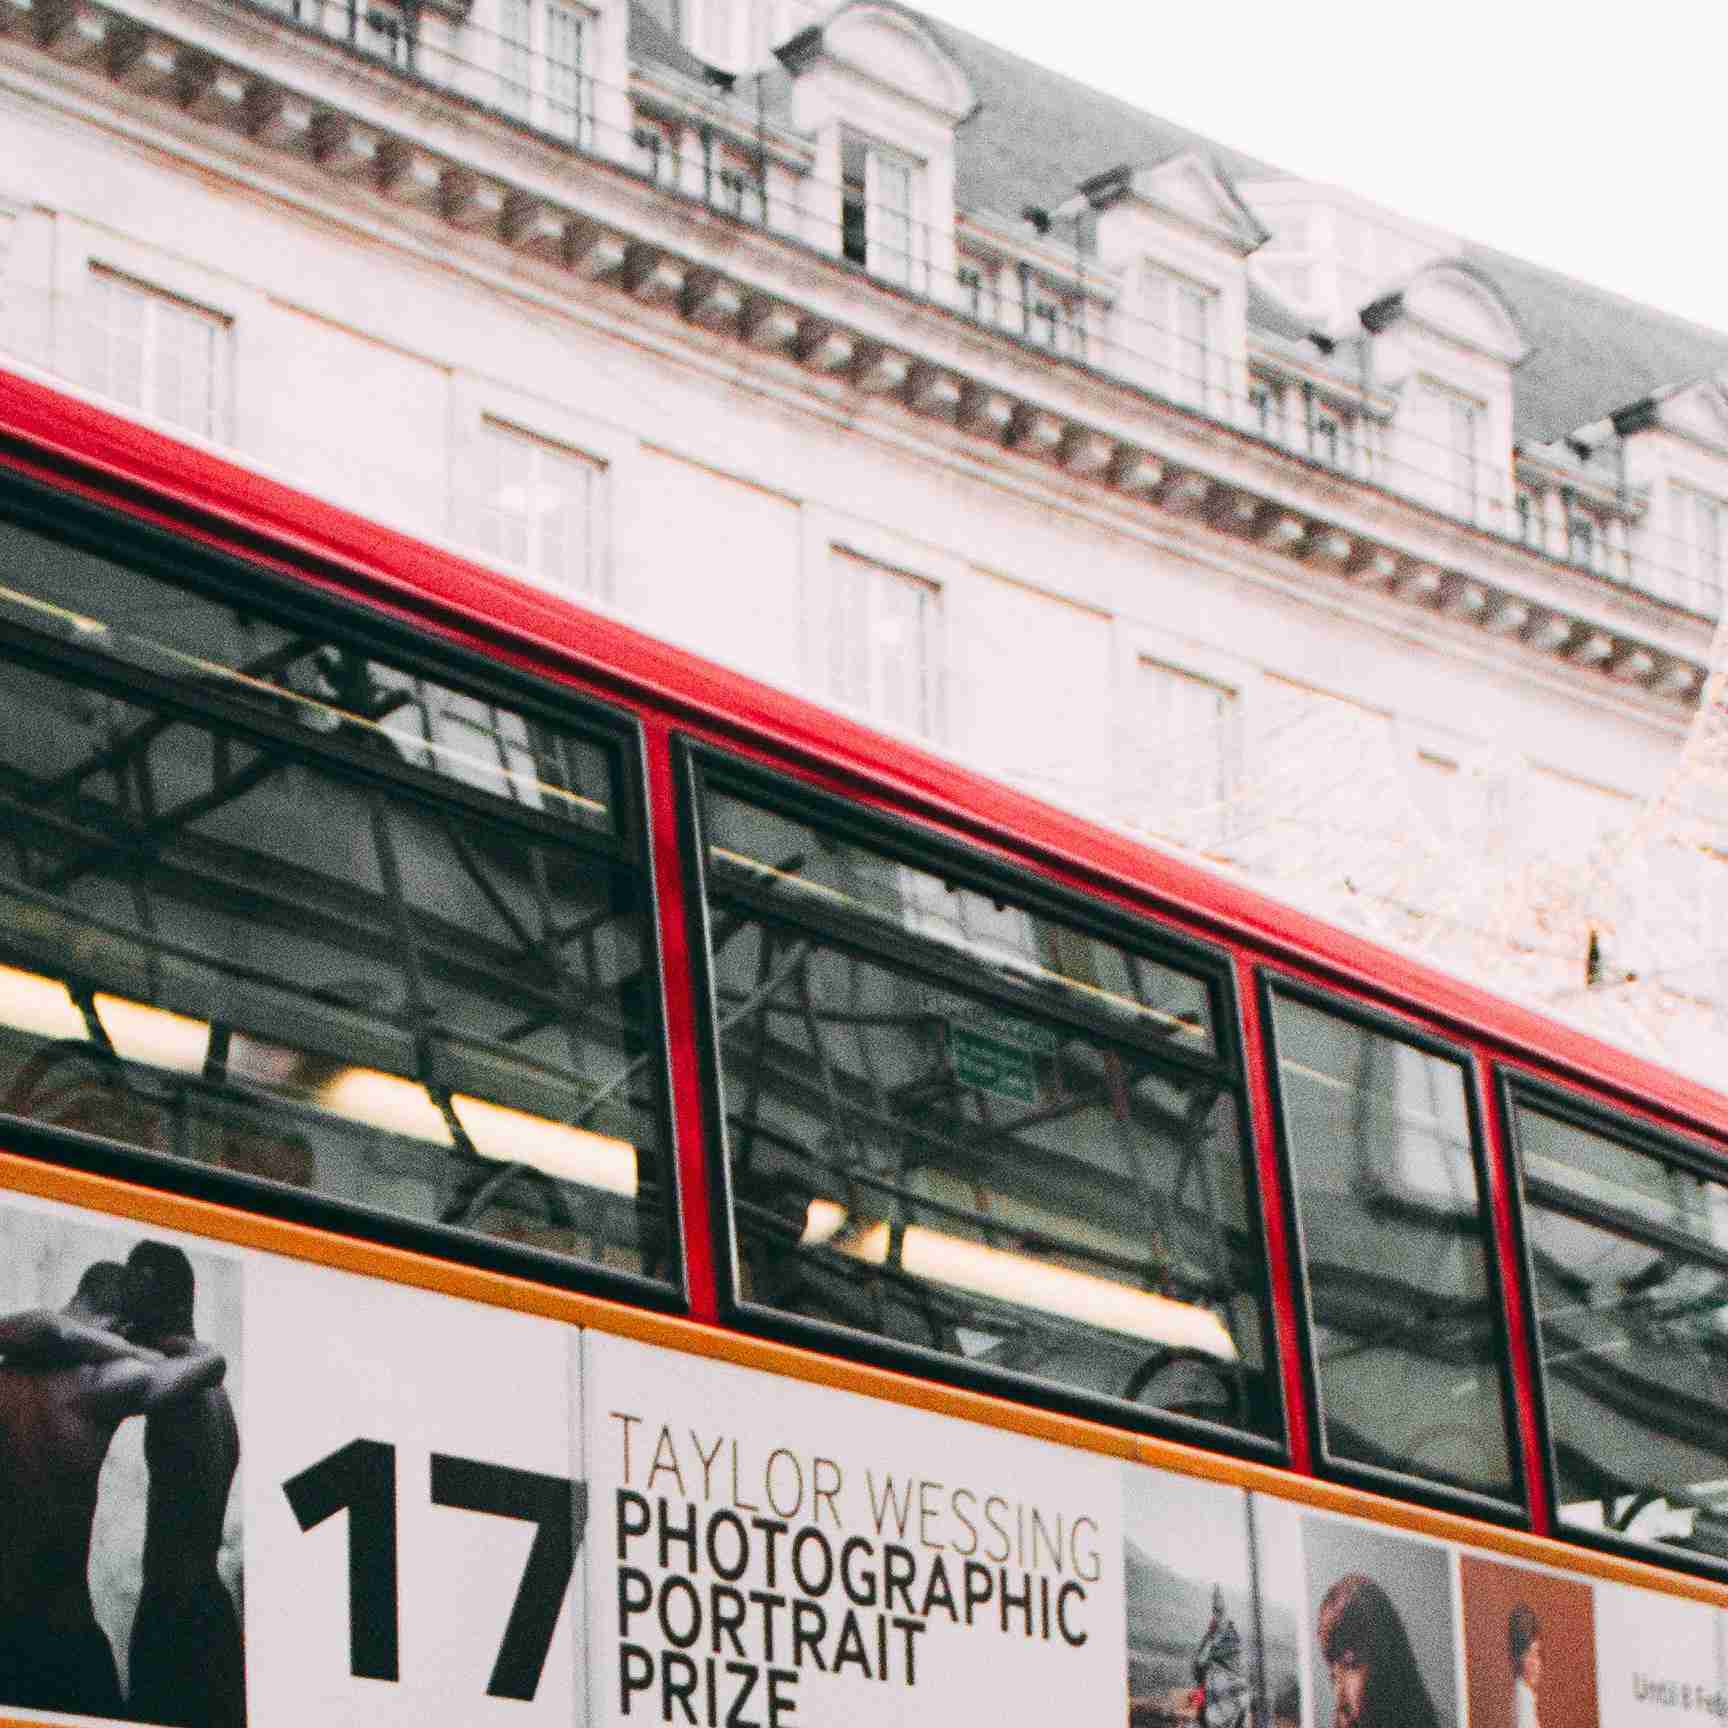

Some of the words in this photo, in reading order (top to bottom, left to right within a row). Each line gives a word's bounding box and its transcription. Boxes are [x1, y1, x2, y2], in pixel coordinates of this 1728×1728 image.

[282, 1437, 588, 1702] 17
[610, 1411, 842, 1527] TAYLOR
[866, 1474, 1101, 1584] WESSING
[615, 1488, 1088, 1647] PHOTOGRAPHIC
[617, 1566, 926, 1687] PORTRAIT
